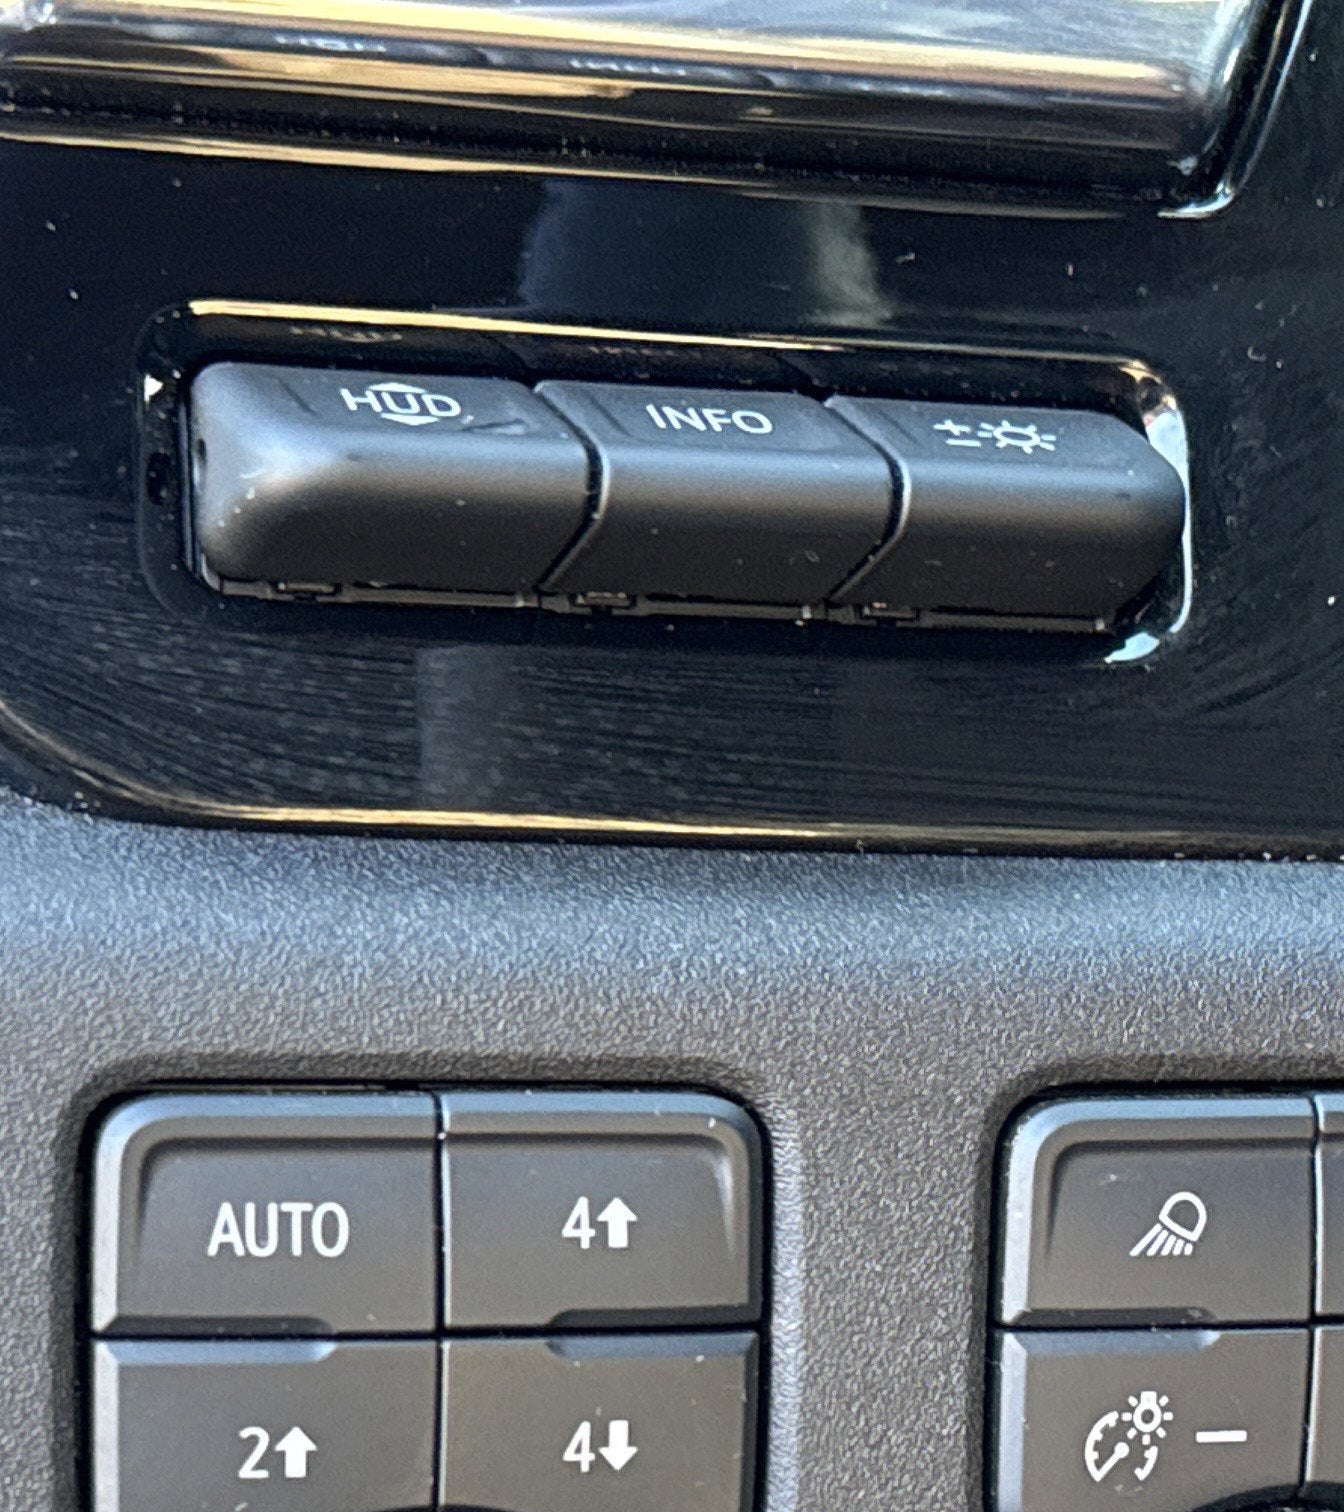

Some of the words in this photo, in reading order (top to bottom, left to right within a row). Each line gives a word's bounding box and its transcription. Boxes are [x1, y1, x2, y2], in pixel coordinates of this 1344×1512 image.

[340, 387, 462, 418] HUD
[645, 403, 773, 434] INFO
[207, 1201, 350, 1258] AUTO
[561, 1196, 596, 1250] 4
[238, 1426, 271, 1479] 2
[562, 1420, 596, 1473] 4
